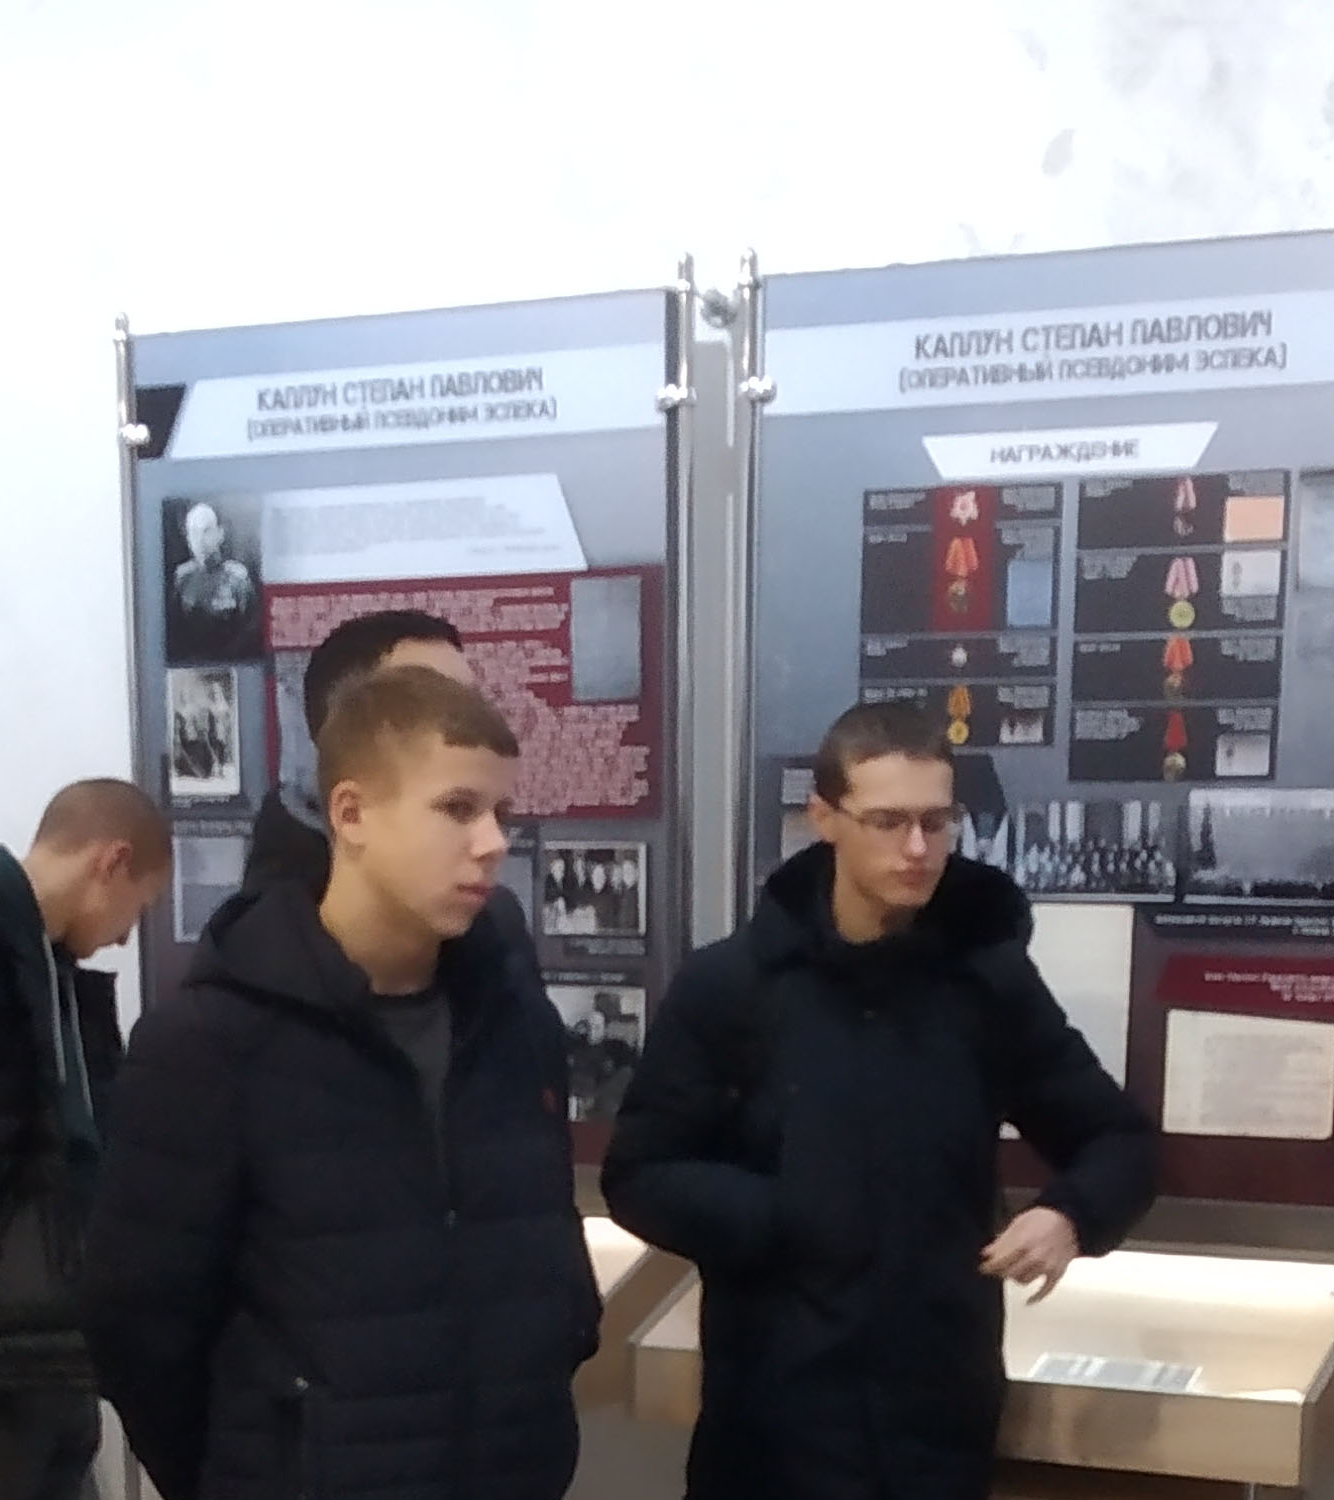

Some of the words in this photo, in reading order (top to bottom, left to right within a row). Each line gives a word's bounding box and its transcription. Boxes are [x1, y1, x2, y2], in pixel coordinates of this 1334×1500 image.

[914, 327, 1015, 361] КАПЛУН
[1021, 321, 1124, 352] СТЕПАН
[1130, 309, 1273, 345] ПАВЛОВИЧ
[1059, 352, 1190, 382] ПСЕВДОНИМ
[257, 383, 337, 412] КАПЛУН
[342, 375, 425, 405] СТЕПАН
[430, 366, 544, 399] ПАВЛОВИЧ
[990, 437, 1140, 464] НАГРАЖДЕНИЕ
